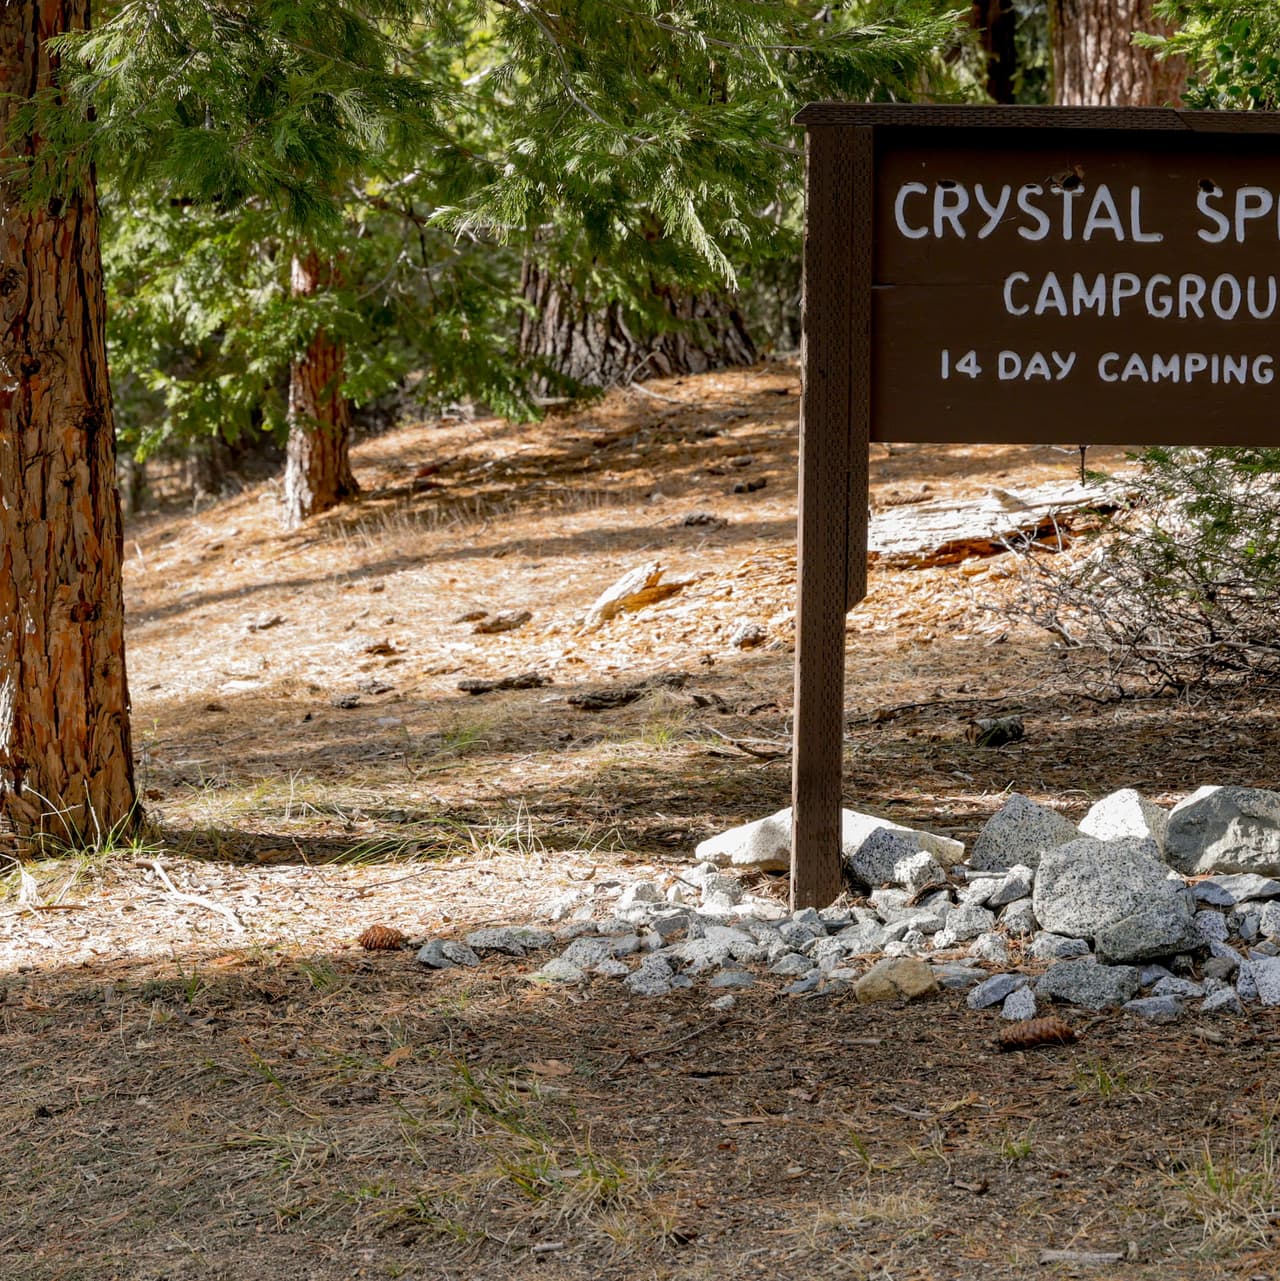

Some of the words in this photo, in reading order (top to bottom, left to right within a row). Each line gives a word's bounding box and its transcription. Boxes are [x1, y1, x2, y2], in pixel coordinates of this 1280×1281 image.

[894, 181, 1163, 243] CRYSTAL
[940, 349, 982, 380] 14
[998, 350, 1076, 381] DAY
[1097, 351, 1274, 385] CAMPING
